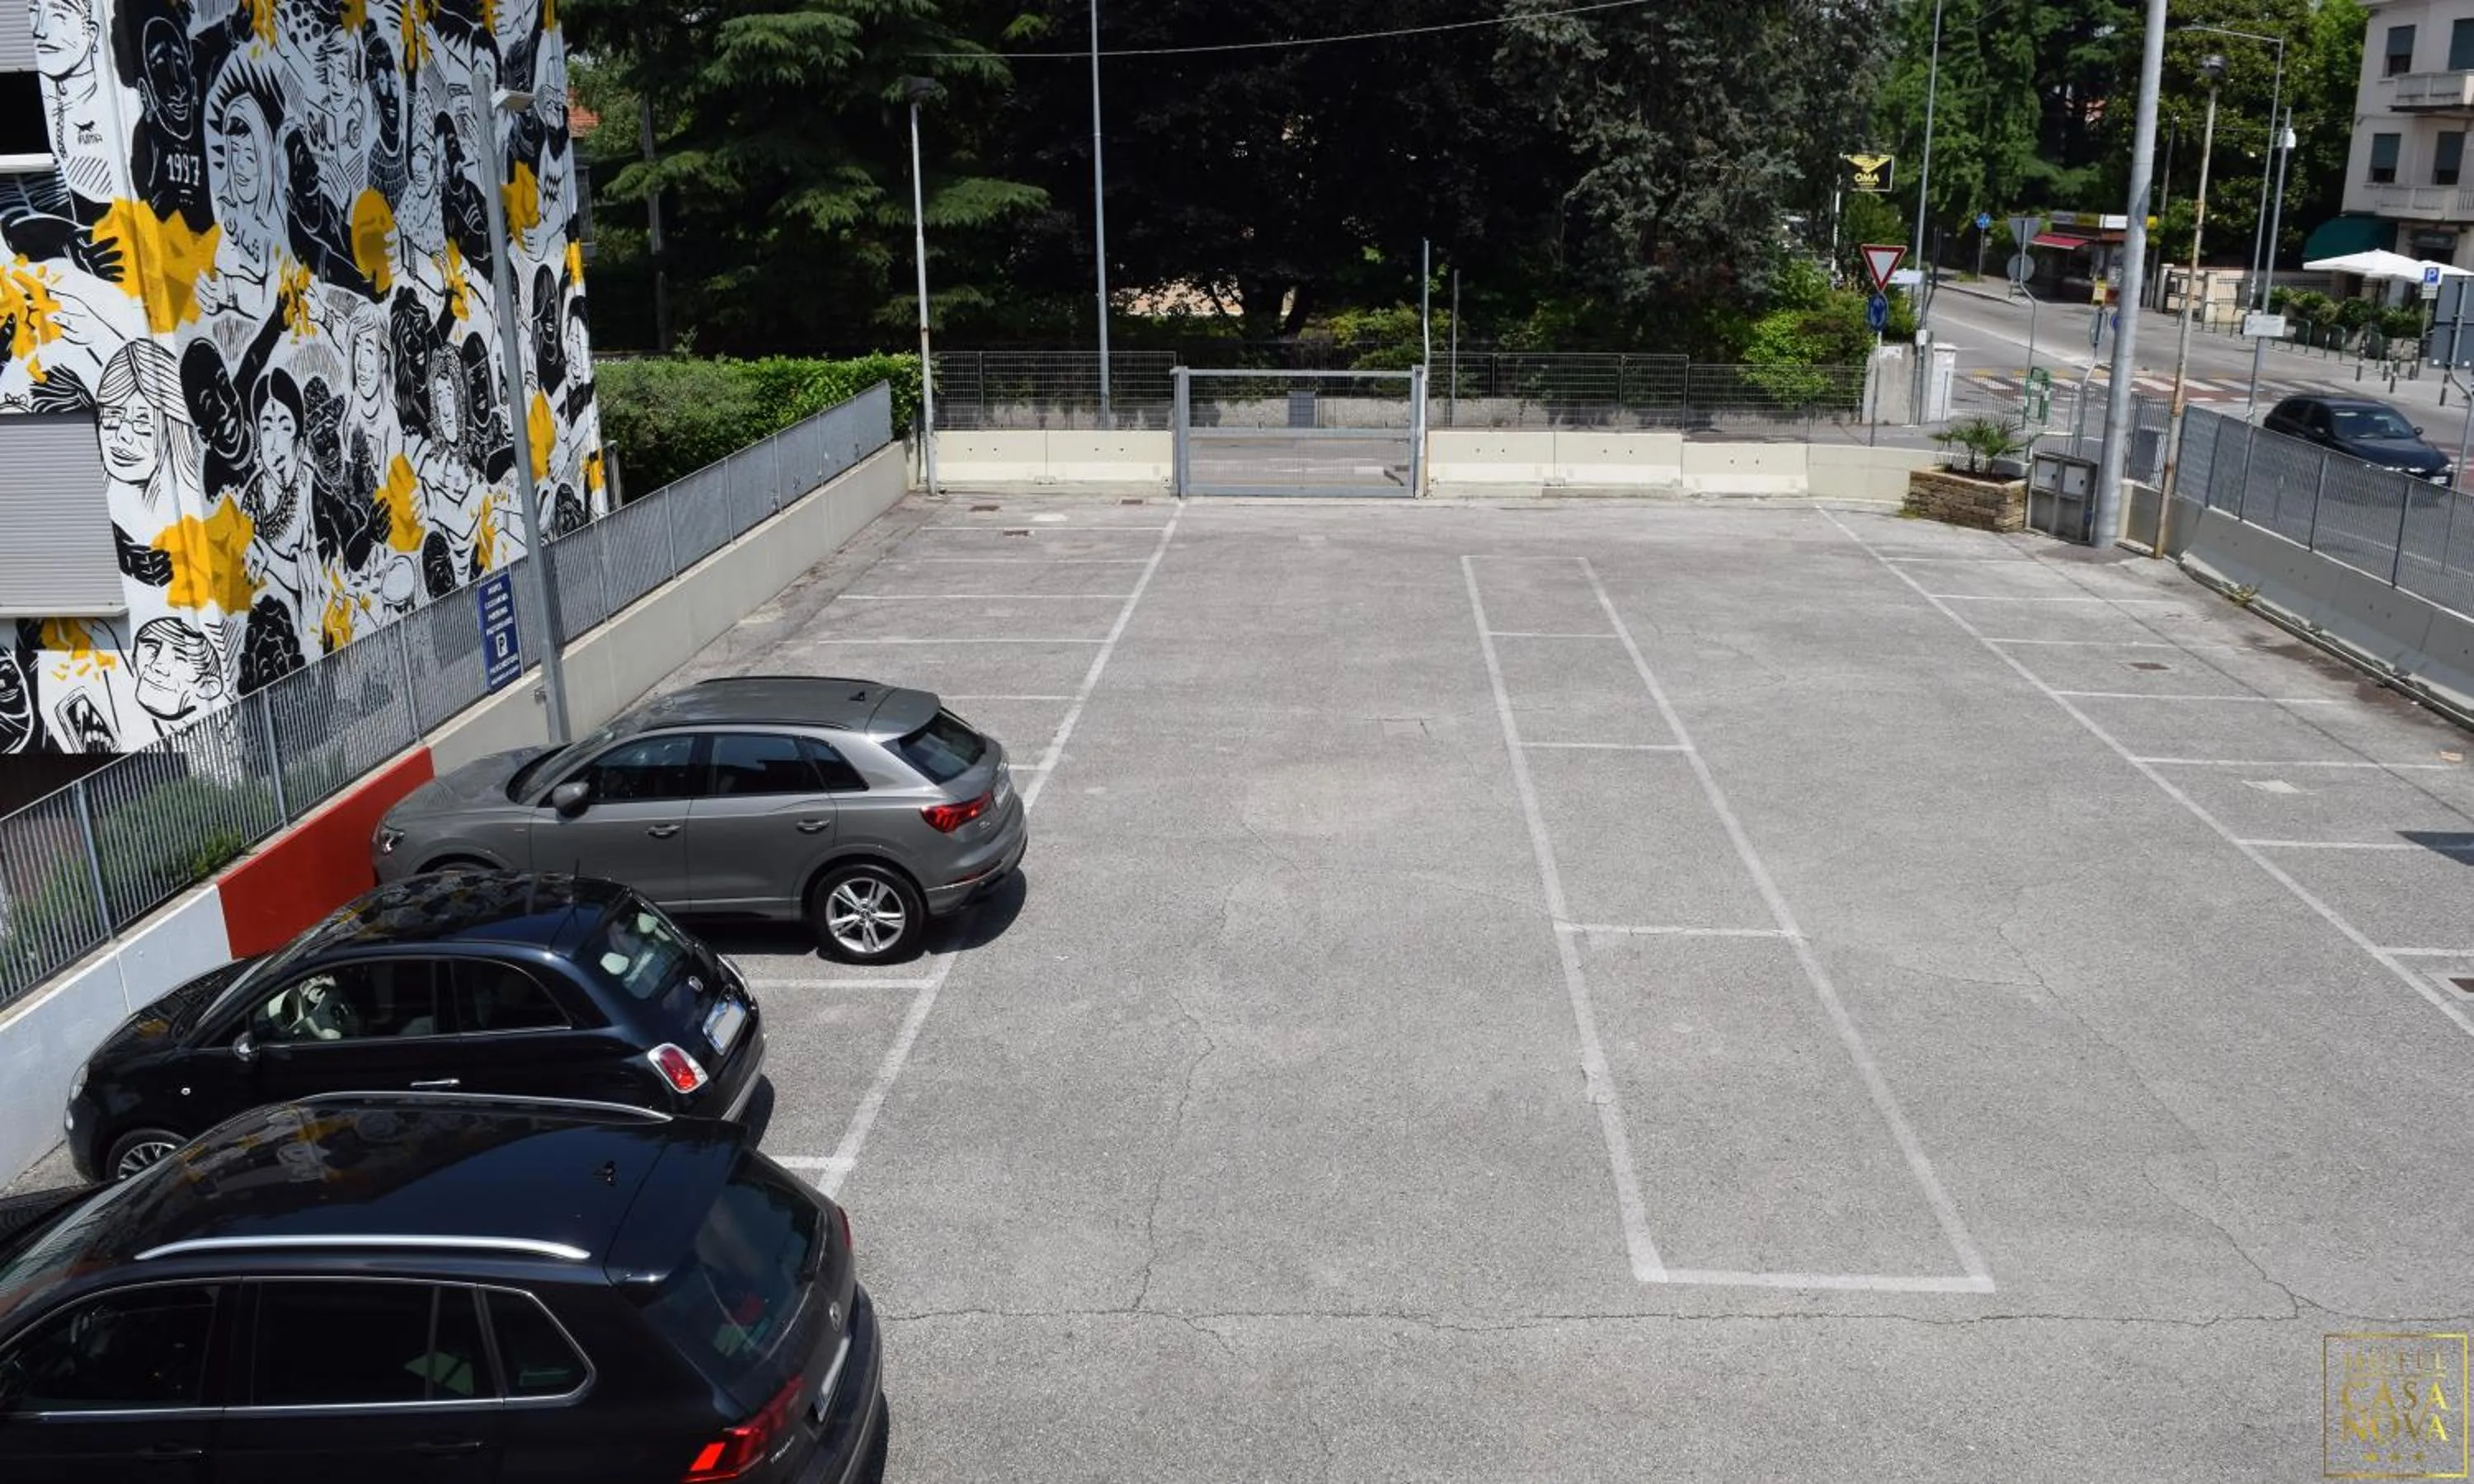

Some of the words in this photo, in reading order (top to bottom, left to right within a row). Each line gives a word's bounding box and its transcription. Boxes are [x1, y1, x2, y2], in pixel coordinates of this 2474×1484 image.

[166, 153, 200, 187] 1997
[2427, 268, 2437, 281] P
[498, 636, 505, 654] P
